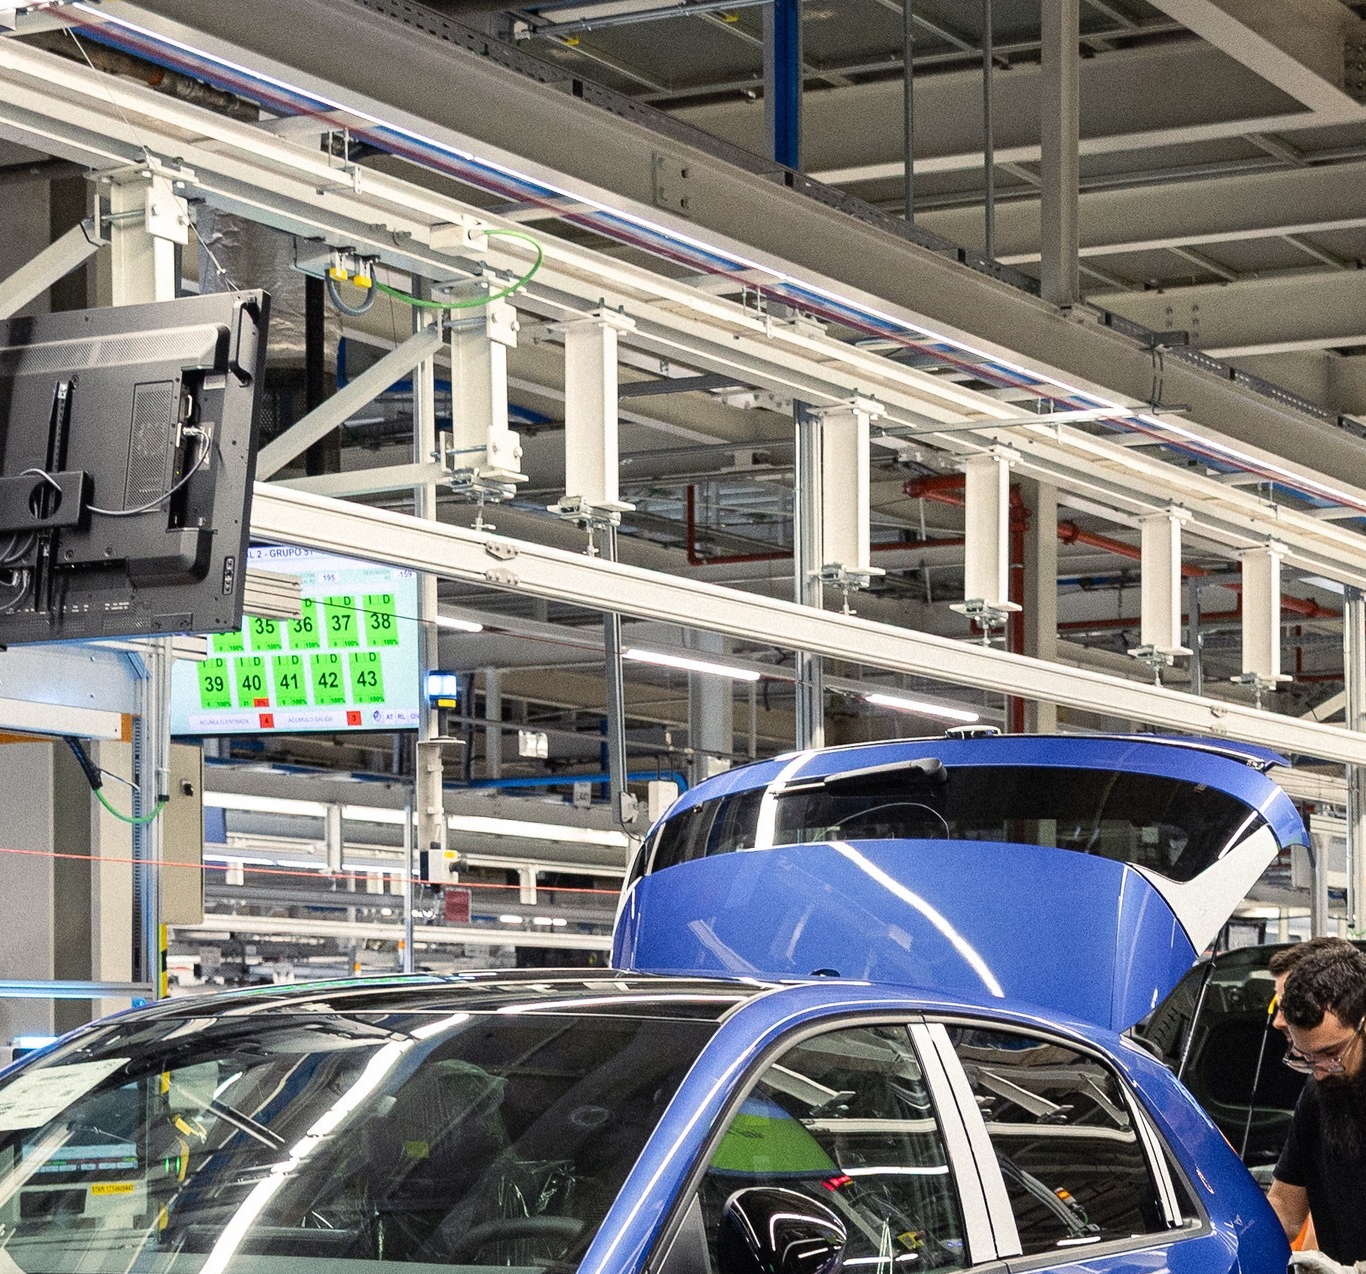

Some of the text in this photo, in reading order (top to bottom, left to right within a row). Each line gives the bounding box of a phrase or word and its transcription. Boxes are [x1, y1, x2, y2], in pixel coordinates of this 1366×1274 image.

[257, 550, 262, 559] 2
[269, 547, 302, 558] GRUPO
[304, 598, 312, 607] D
[343, 596, 351, 605] D
[383, 594, 390, 604] D
[255, 618, 275, 634] 35
[293, 616, 313, 633] 36
[331, 614, 351, 631] 37
[370, 612, 391, 629] 38
[216, 658, 223, 667] D
[253, 657, 261, 666] D
[292, 655, 299, 665] D
[330, 653, 338, 663] D
[369, 652, 377, 662] D
[204, 676, 224, 692] 39
[242, 675, 261, 691] 40
[280, 673, 298, 689] 41
[318, 672, 339, 688] 42
[357, 670, 378, 687] 43
